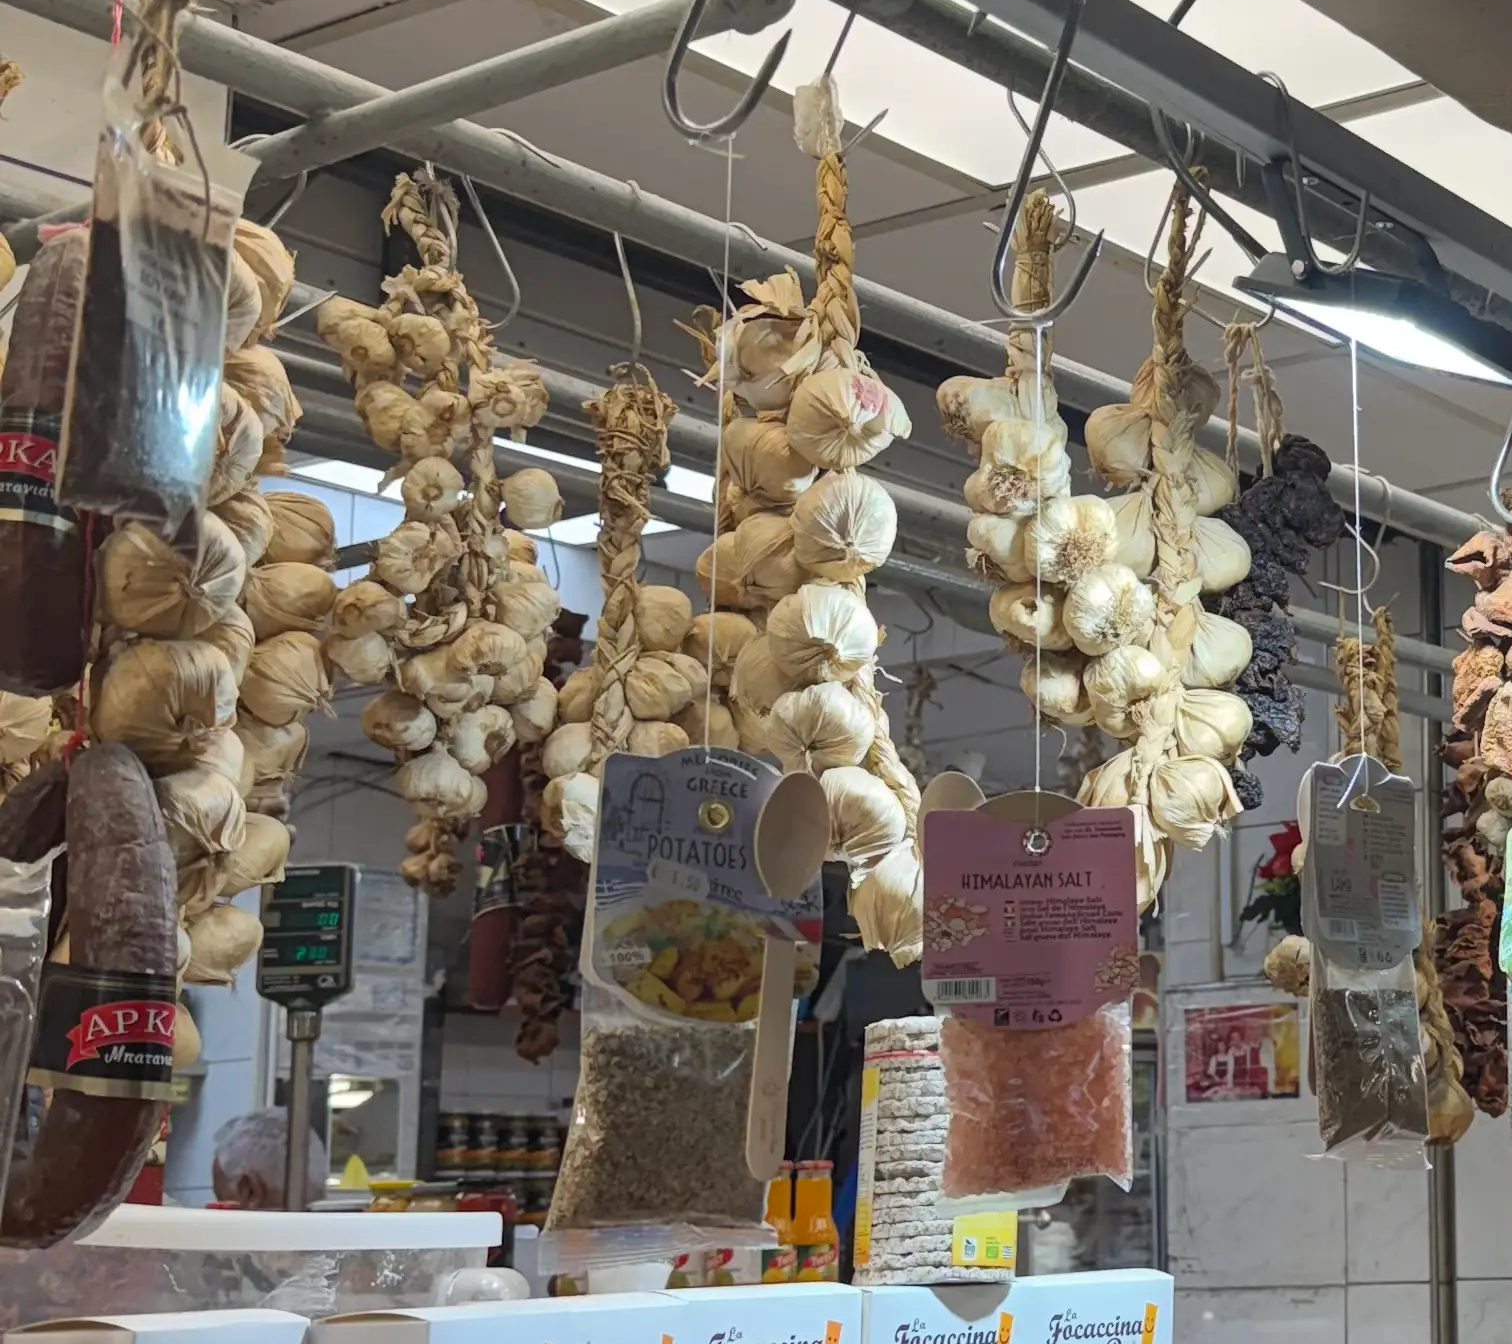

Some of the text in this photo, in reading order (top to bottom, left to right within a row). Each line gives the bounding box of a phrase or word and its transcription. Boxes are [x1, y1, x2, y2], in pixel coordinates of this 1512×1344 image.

[687, 778, 748, 799] GREECE
[647, 834, 747, 871] POTATOES
[961, 871, 1092, 890] HIMALAYAN SALT
[85, 1009, 176, 1042] ΑΡΚ
